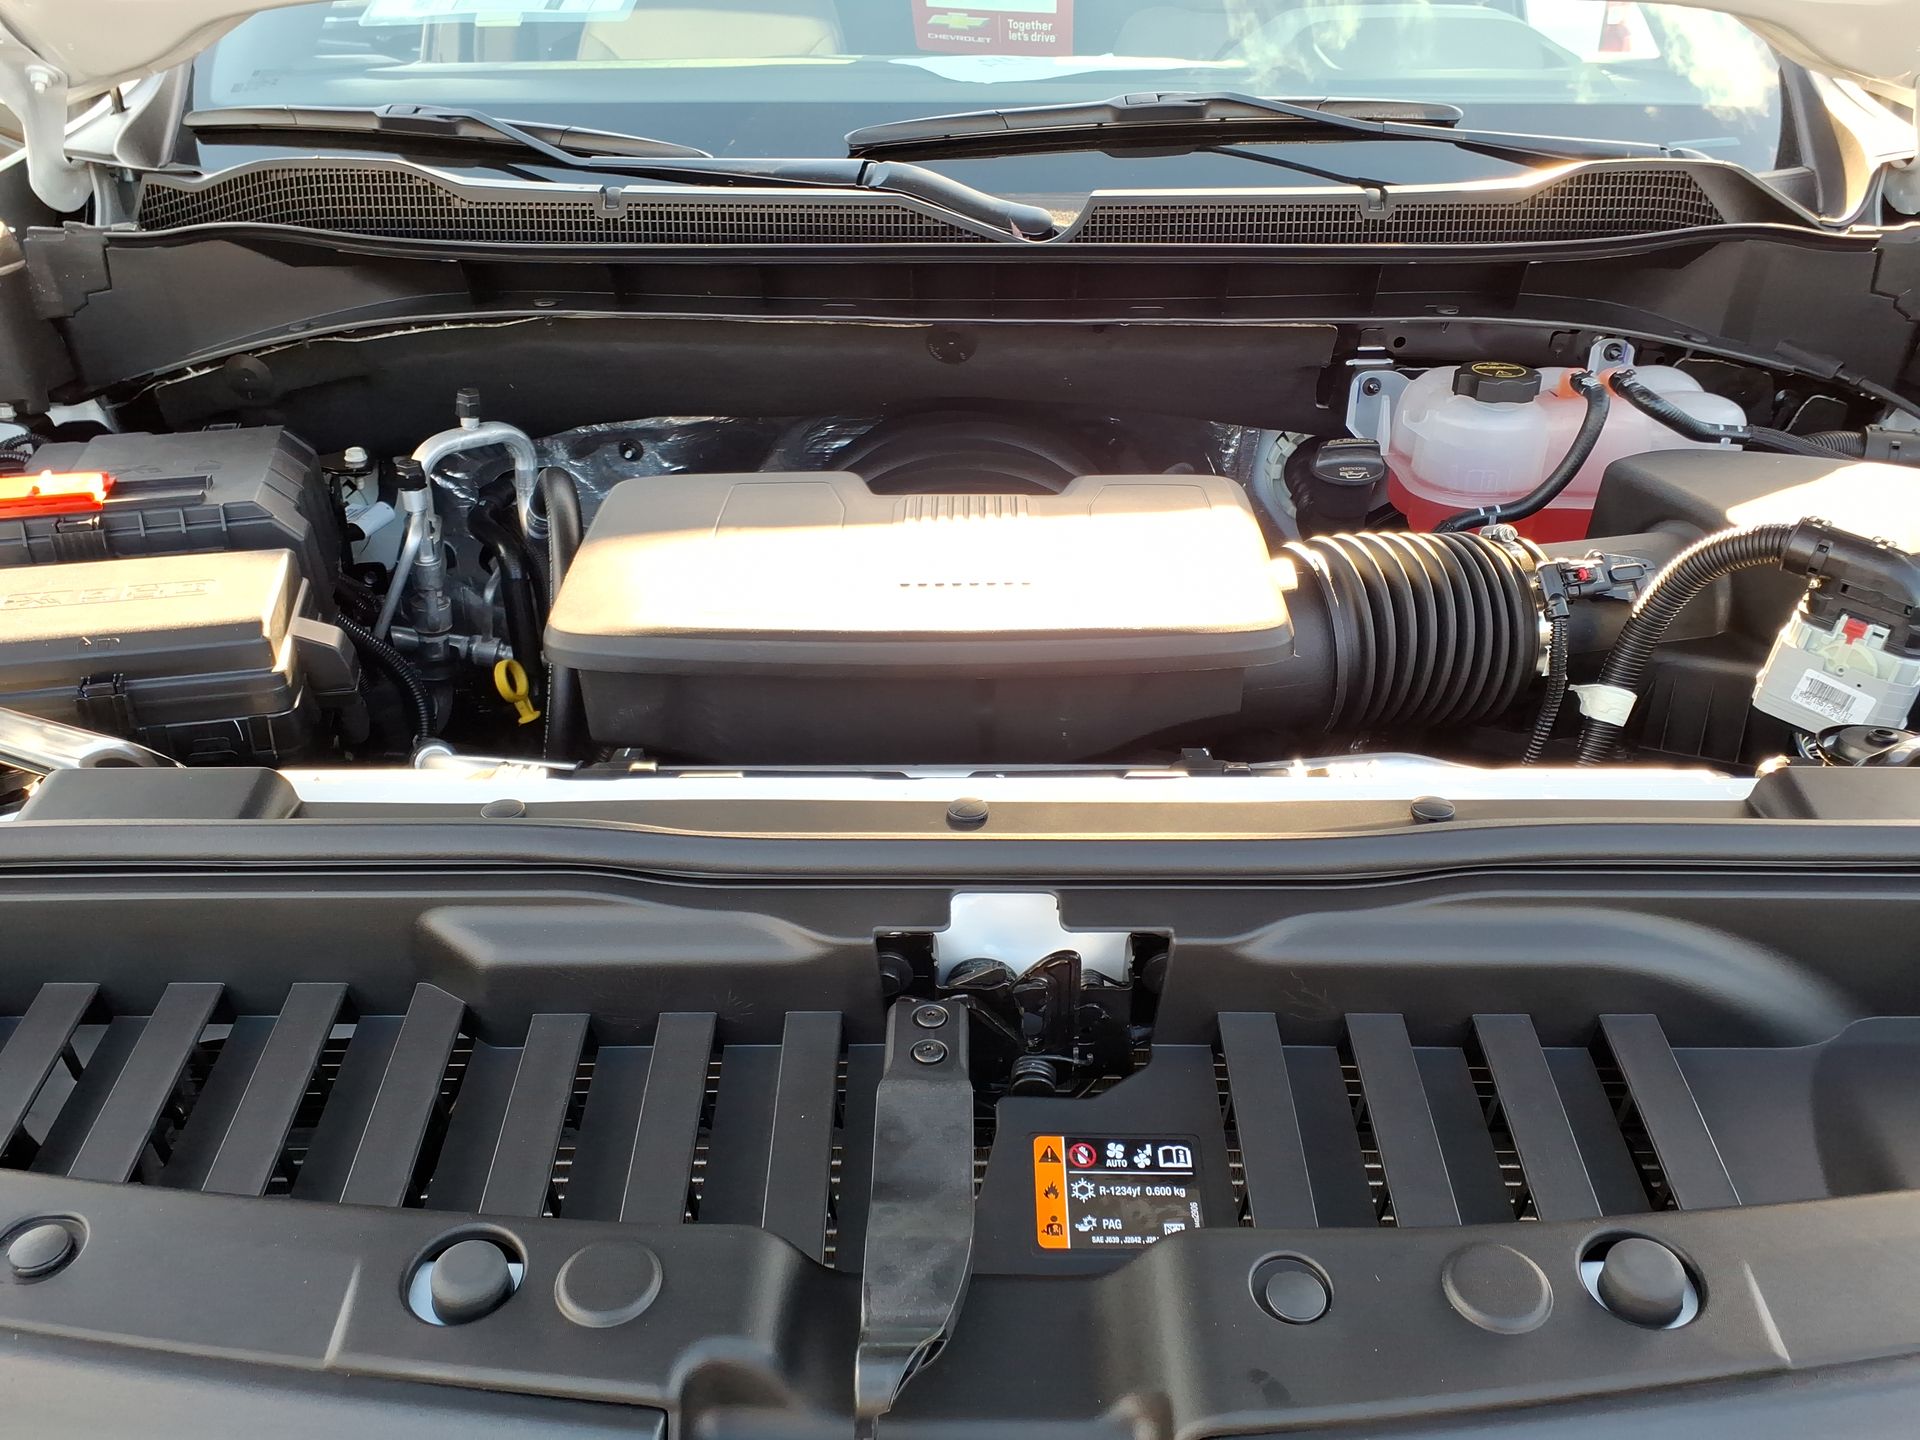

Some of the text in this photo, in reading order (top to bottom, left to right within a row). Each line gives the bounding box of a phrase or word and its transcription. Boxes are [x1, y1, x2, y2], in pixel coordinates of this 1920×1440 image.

[1007, 19, 1053, 32] Together
[927, 32, 992, 44] CHEVROLET
[1008, 32, 1056, 43] let's drive
[1106, 1159, 1128, 1168] AUTO
[1099, 1186, 1186, 1198] R-1234yf 0.600 kg
[1102, 1219, 1123, 1230] PAG
